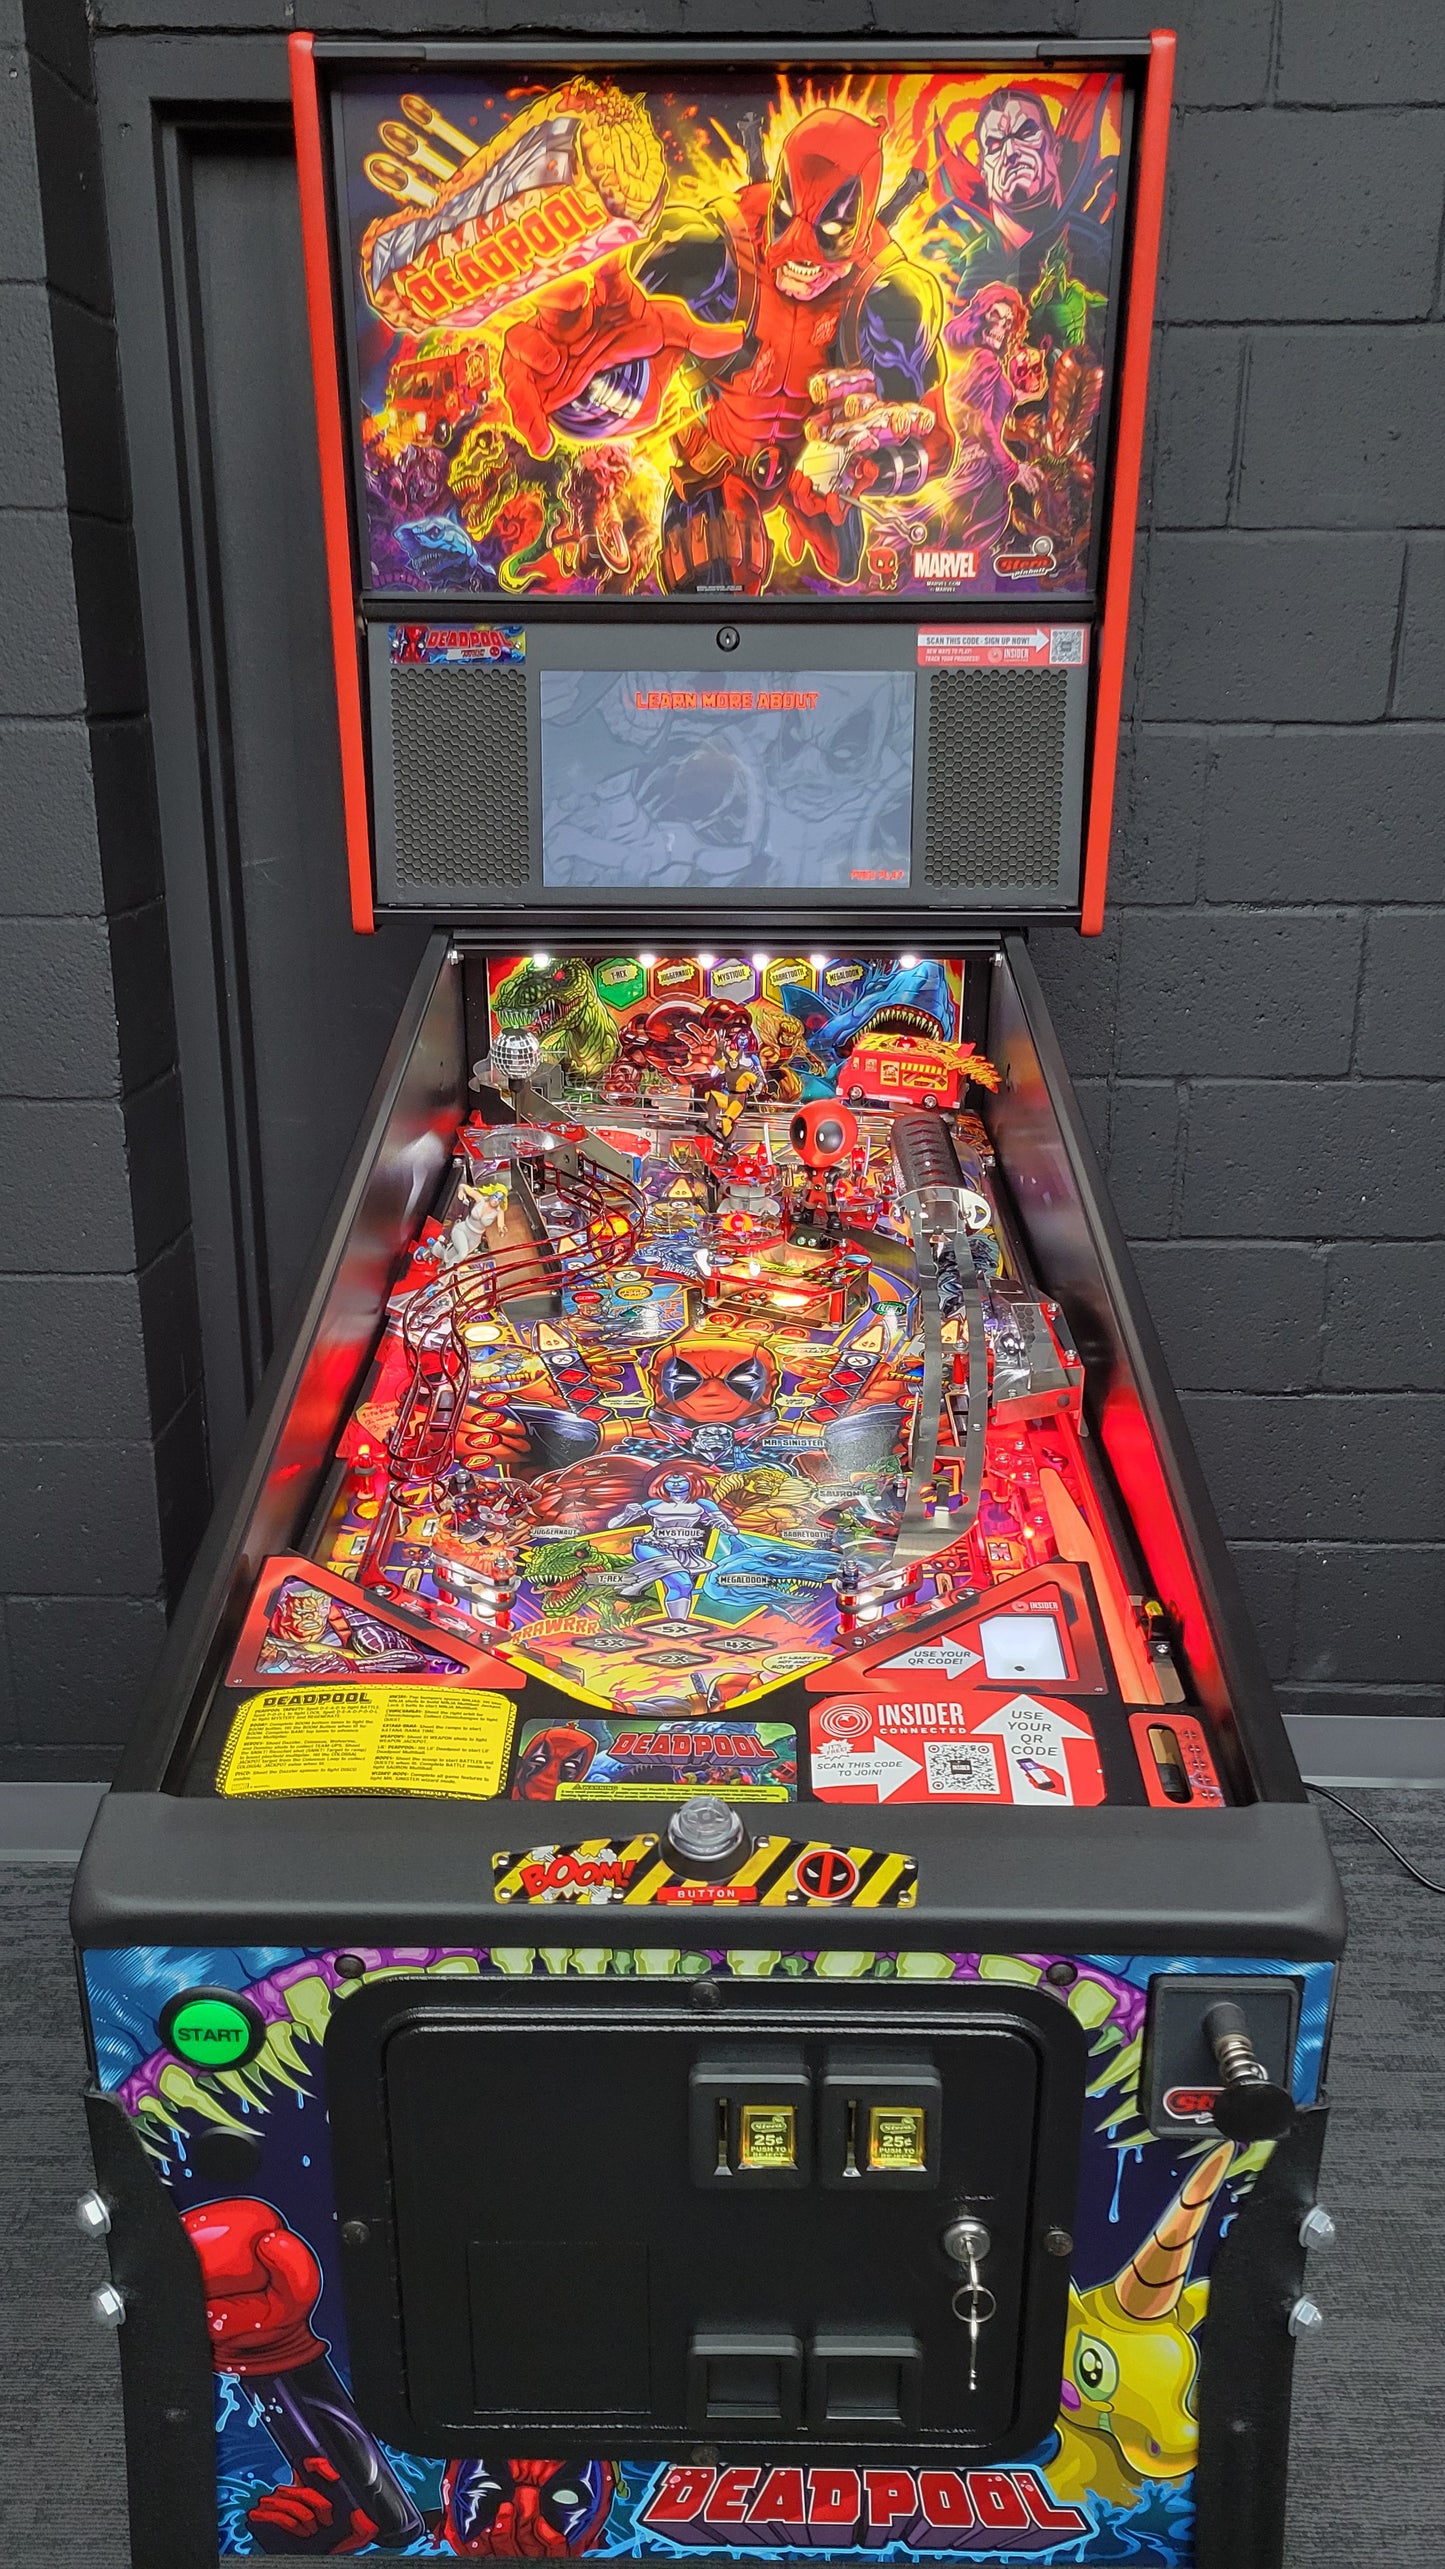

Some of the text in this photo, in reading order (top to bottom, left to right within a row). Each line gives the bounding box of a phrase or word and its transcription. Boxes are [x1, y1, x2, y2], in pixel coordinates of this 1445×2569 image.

[404, 186, 608, 318] DEADPOOL
[914, 552, 976, 578] MARVEL
[426, 631, 514, 648] DEADPOOL
[927, 636, 944, 645] SCAN
[946, 636, 960, 645] THIS
[962, 636, 979, 645] CODE
[984, 636, 1000, 645] SIGN
[1001, 636, 1010, 645] UP
[1011, 636, 1030, 645] NOW!
[1004, 648, 1029, 658] INSIDER
[636, 692, 819, 710] LEARN MORE ABOUT
[878, 870, 904, 880] PLAY
[610, 970, 627, 980] T-REX
[661, 968, 690, 982] JUGGERNAUT
[717, 969, 745, 980] MYSTIQUE
[772, 968, 804, 980] SABRETOOTH
[830, 969, 860, 980] MEGALODON
[763, 1439, 825, 1448] MR. SINISTER
[819, 1489, 860, 1498] SAURON
[532, 1528, 578, 1537] JUGGERNAUT
[657, 1529, 701, 1538] MYSTIQUE
[782, 1531, 830, 1539] SABRETOOTH
[988, 1543, 1012, 1561] M
[599, 1574, 624, 1583] T-REX
[720, 1576, 767, 1584] MEGALODON
[1030, 1601, 1058, 1609] INSIDER
[661, 1625, 690, 1634] 5X
[594, 1638, 626, 1648] 3X
[724, 1640, 753, 1649] 4X
[658, 1654, 689, 1664] 2X
[908, 1658, 924, 1666] QR
[264, 1692, 372, 1707] DEADPOOL
[878, 1702, 965, 1726] INSIDER
[1012, 1711, 1044, 1720] USE
[1008, 1721, 1051, 1732] YOUR
[1021, 1734, 1043, 1745] QR
[608, 1734, 778, 1762] DEADPOOL
[827, 1747, 847, 1755] FREE!
[1012, 1746, 1058, 1756] CODE
[520, 1856, 637, 1894] BOOM!
[677, 1889, 736, 1899] BUTTON
[177, 2028, 244, 2042] START
[754, 2135, 784, 2146] 25¢
[883, 2136, 912, 2147] 25¢
[643, 2467, 1088, 2531] DEADPOOL
